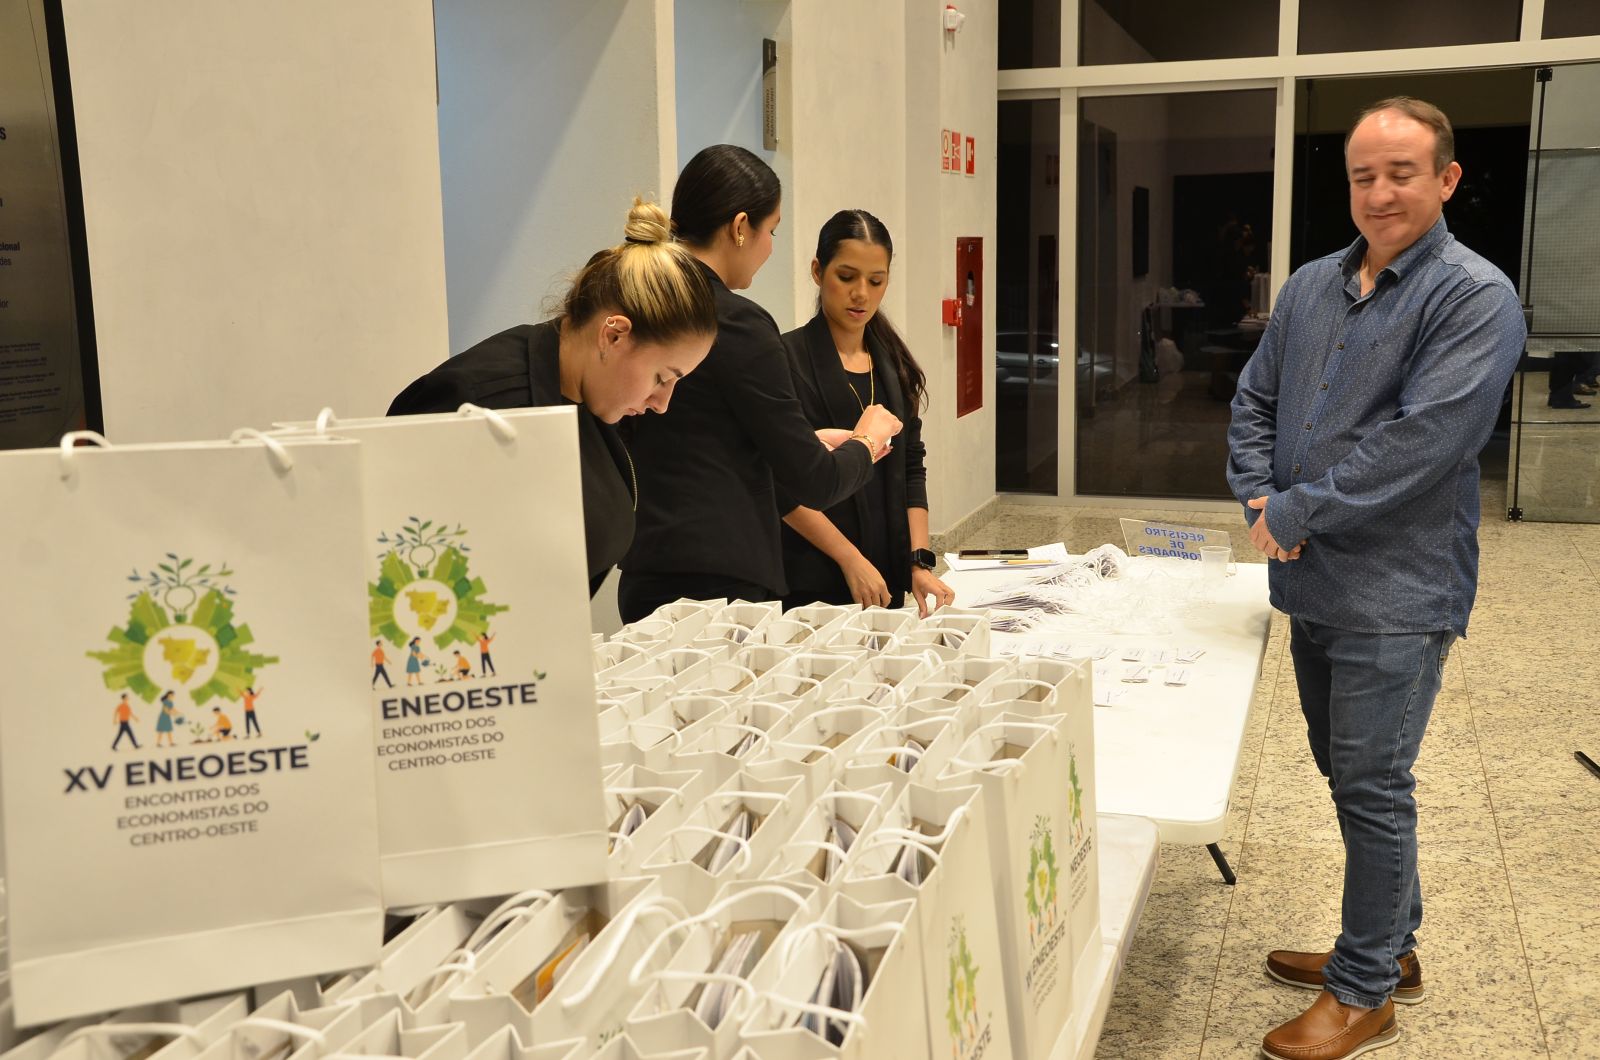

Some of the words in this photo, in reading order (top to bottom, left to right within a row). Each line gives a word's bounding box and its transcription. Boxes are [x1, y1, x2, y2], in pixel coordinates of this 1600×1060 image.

[382, 683, 538, 720] ENEOESTE
[382, 720, 462, 739] ENCONTRO
[466, 716, 496, 728] DOS
[377, 734, 479, 757] ECONOMISTAS
[482, 731, 504, 744] DO
[63, 764, 113, 794] XV
[125, 745, 309, 787] ENEOESTE
[388, 748, 496, 771] CENTRO-OESTE
[124, 789, 220, 810] ENCONTRO
[225, 782, 260, 799] DOS
[116, 802, 239, 830] ECONOMISTAS
[243, 800, 269, 816] DO
[130, 819, 258, 848] CENTRO-OESTE
[1070, 837, 1092, 876] NEOESTE
